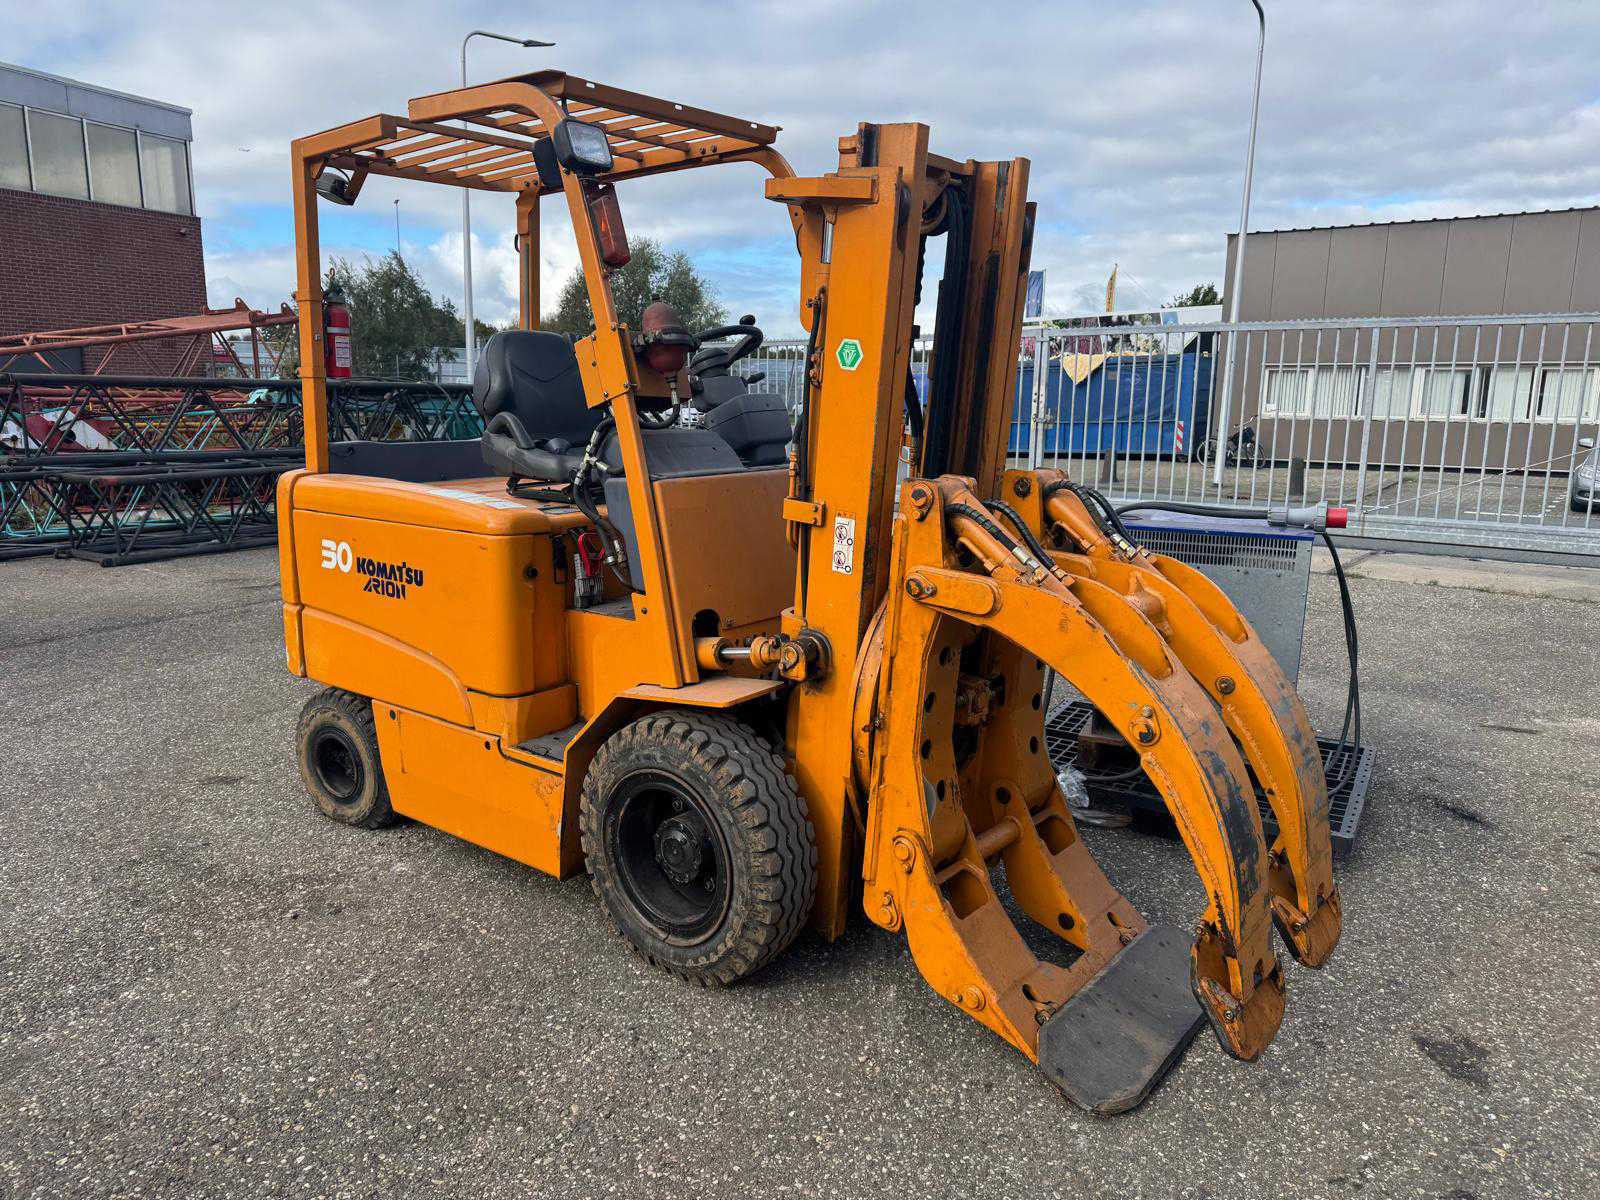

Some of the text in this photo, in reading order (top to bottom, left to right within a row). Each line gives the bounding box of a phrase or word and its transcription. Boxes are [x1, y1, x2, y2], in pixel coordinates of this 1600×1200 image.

[321, 539, 353, 573] 30
[357, 557, 424, 587] KOMATSU
[364, 578, 406, 600] ARION
